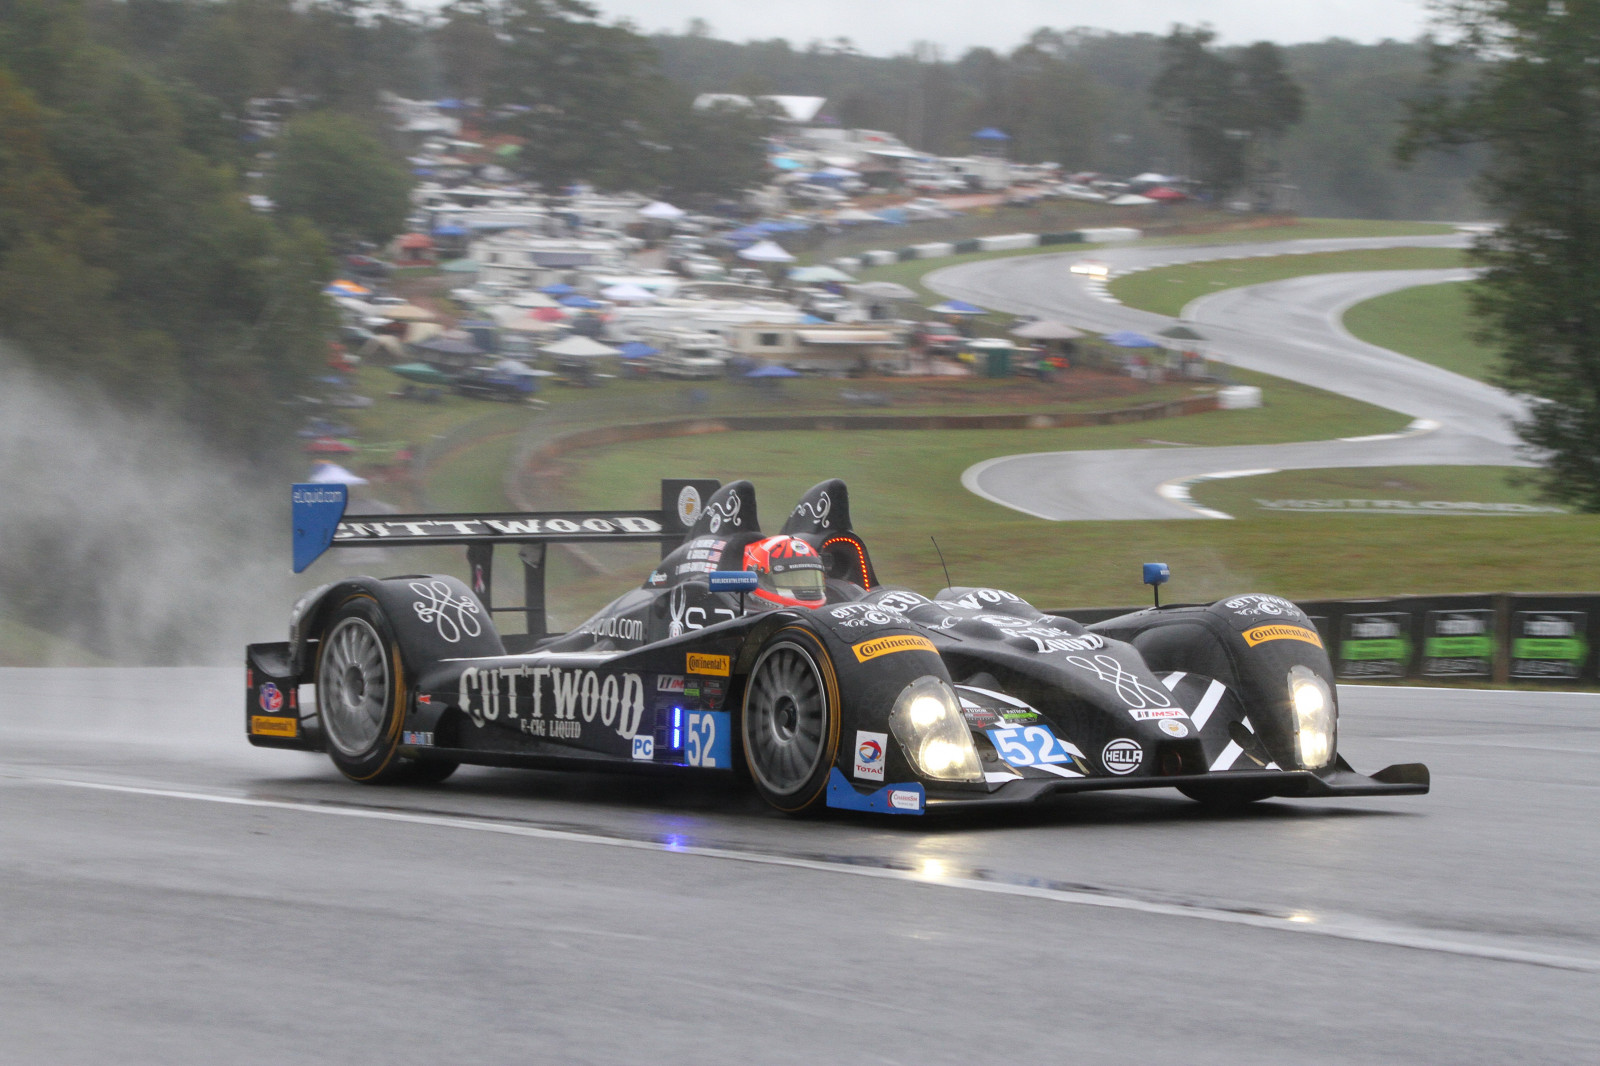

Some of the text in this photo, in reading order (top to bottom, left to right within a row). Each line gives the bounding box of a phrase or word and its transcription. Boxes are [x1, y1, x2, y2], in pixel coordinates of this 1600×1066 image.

[1249, 628, 1311, 642] Continental
[859, 639, 926, 658] Continental
[688, 655, 722, 671] Continental
[458, 663, 645, 740] CUTTWOOD
[550, 721, 582, 740] LIQUID
[688, 713, 716, 767] 52
[633, 738, 652, 756] PC
[994, 726, 1069, 766] 52
[1105, 750, 1143, 763] HELLA
